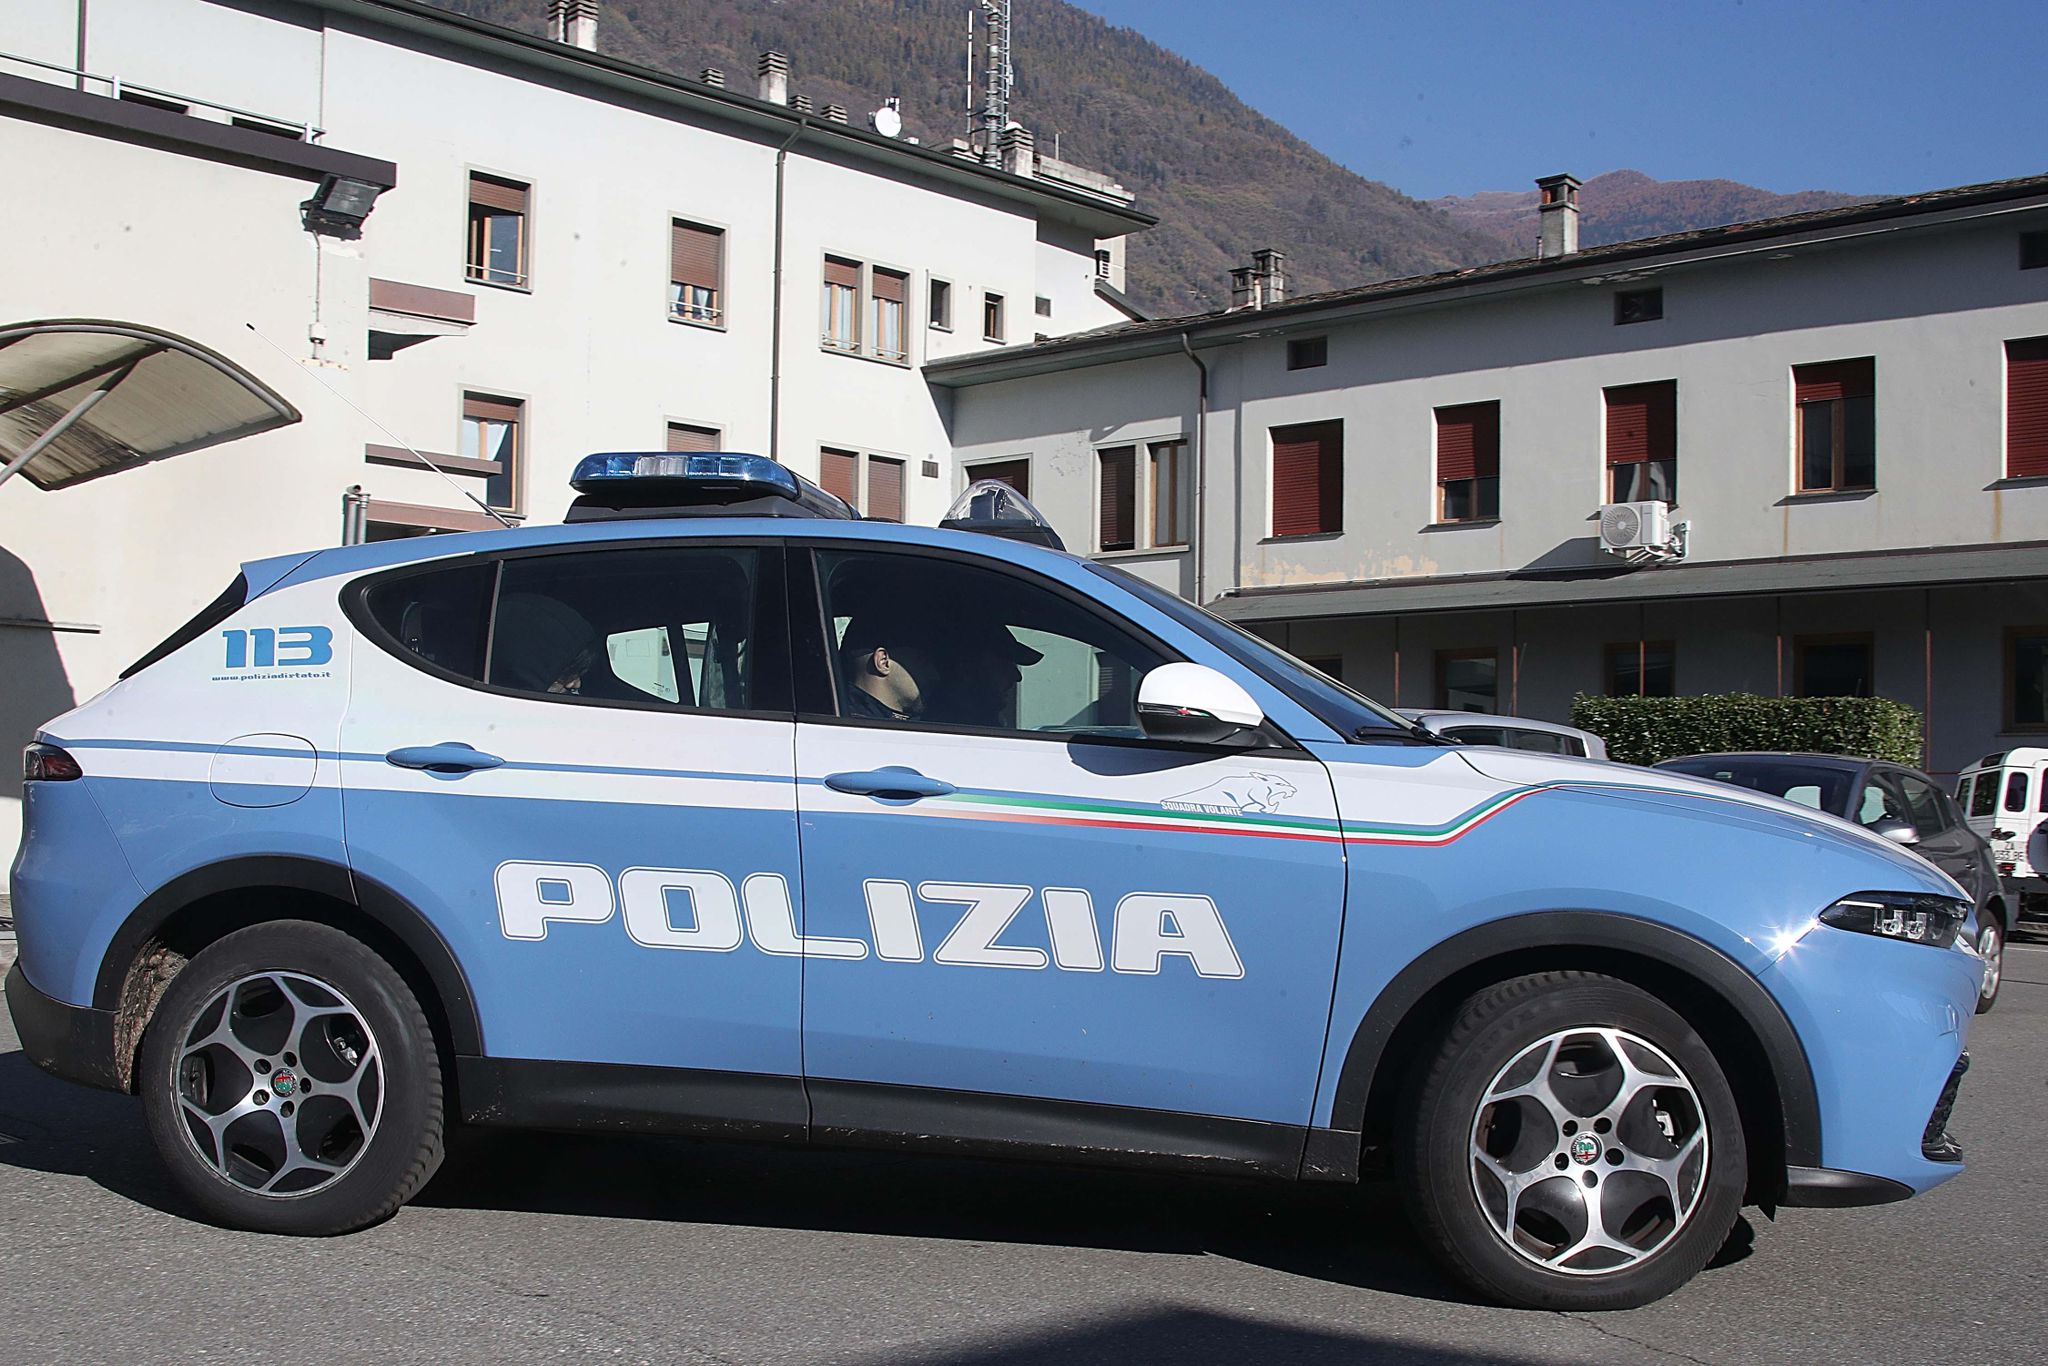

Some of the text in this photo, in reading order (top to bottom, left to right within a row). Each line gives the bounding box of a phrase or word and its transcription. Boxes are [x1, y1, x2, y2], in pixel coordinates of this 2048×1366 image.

[222, 625, 334, 669] 113
[1161, 801, 1242, 816] SQUADRA VOLANTE
[493, 859, 1245, 979] POLIZIA
